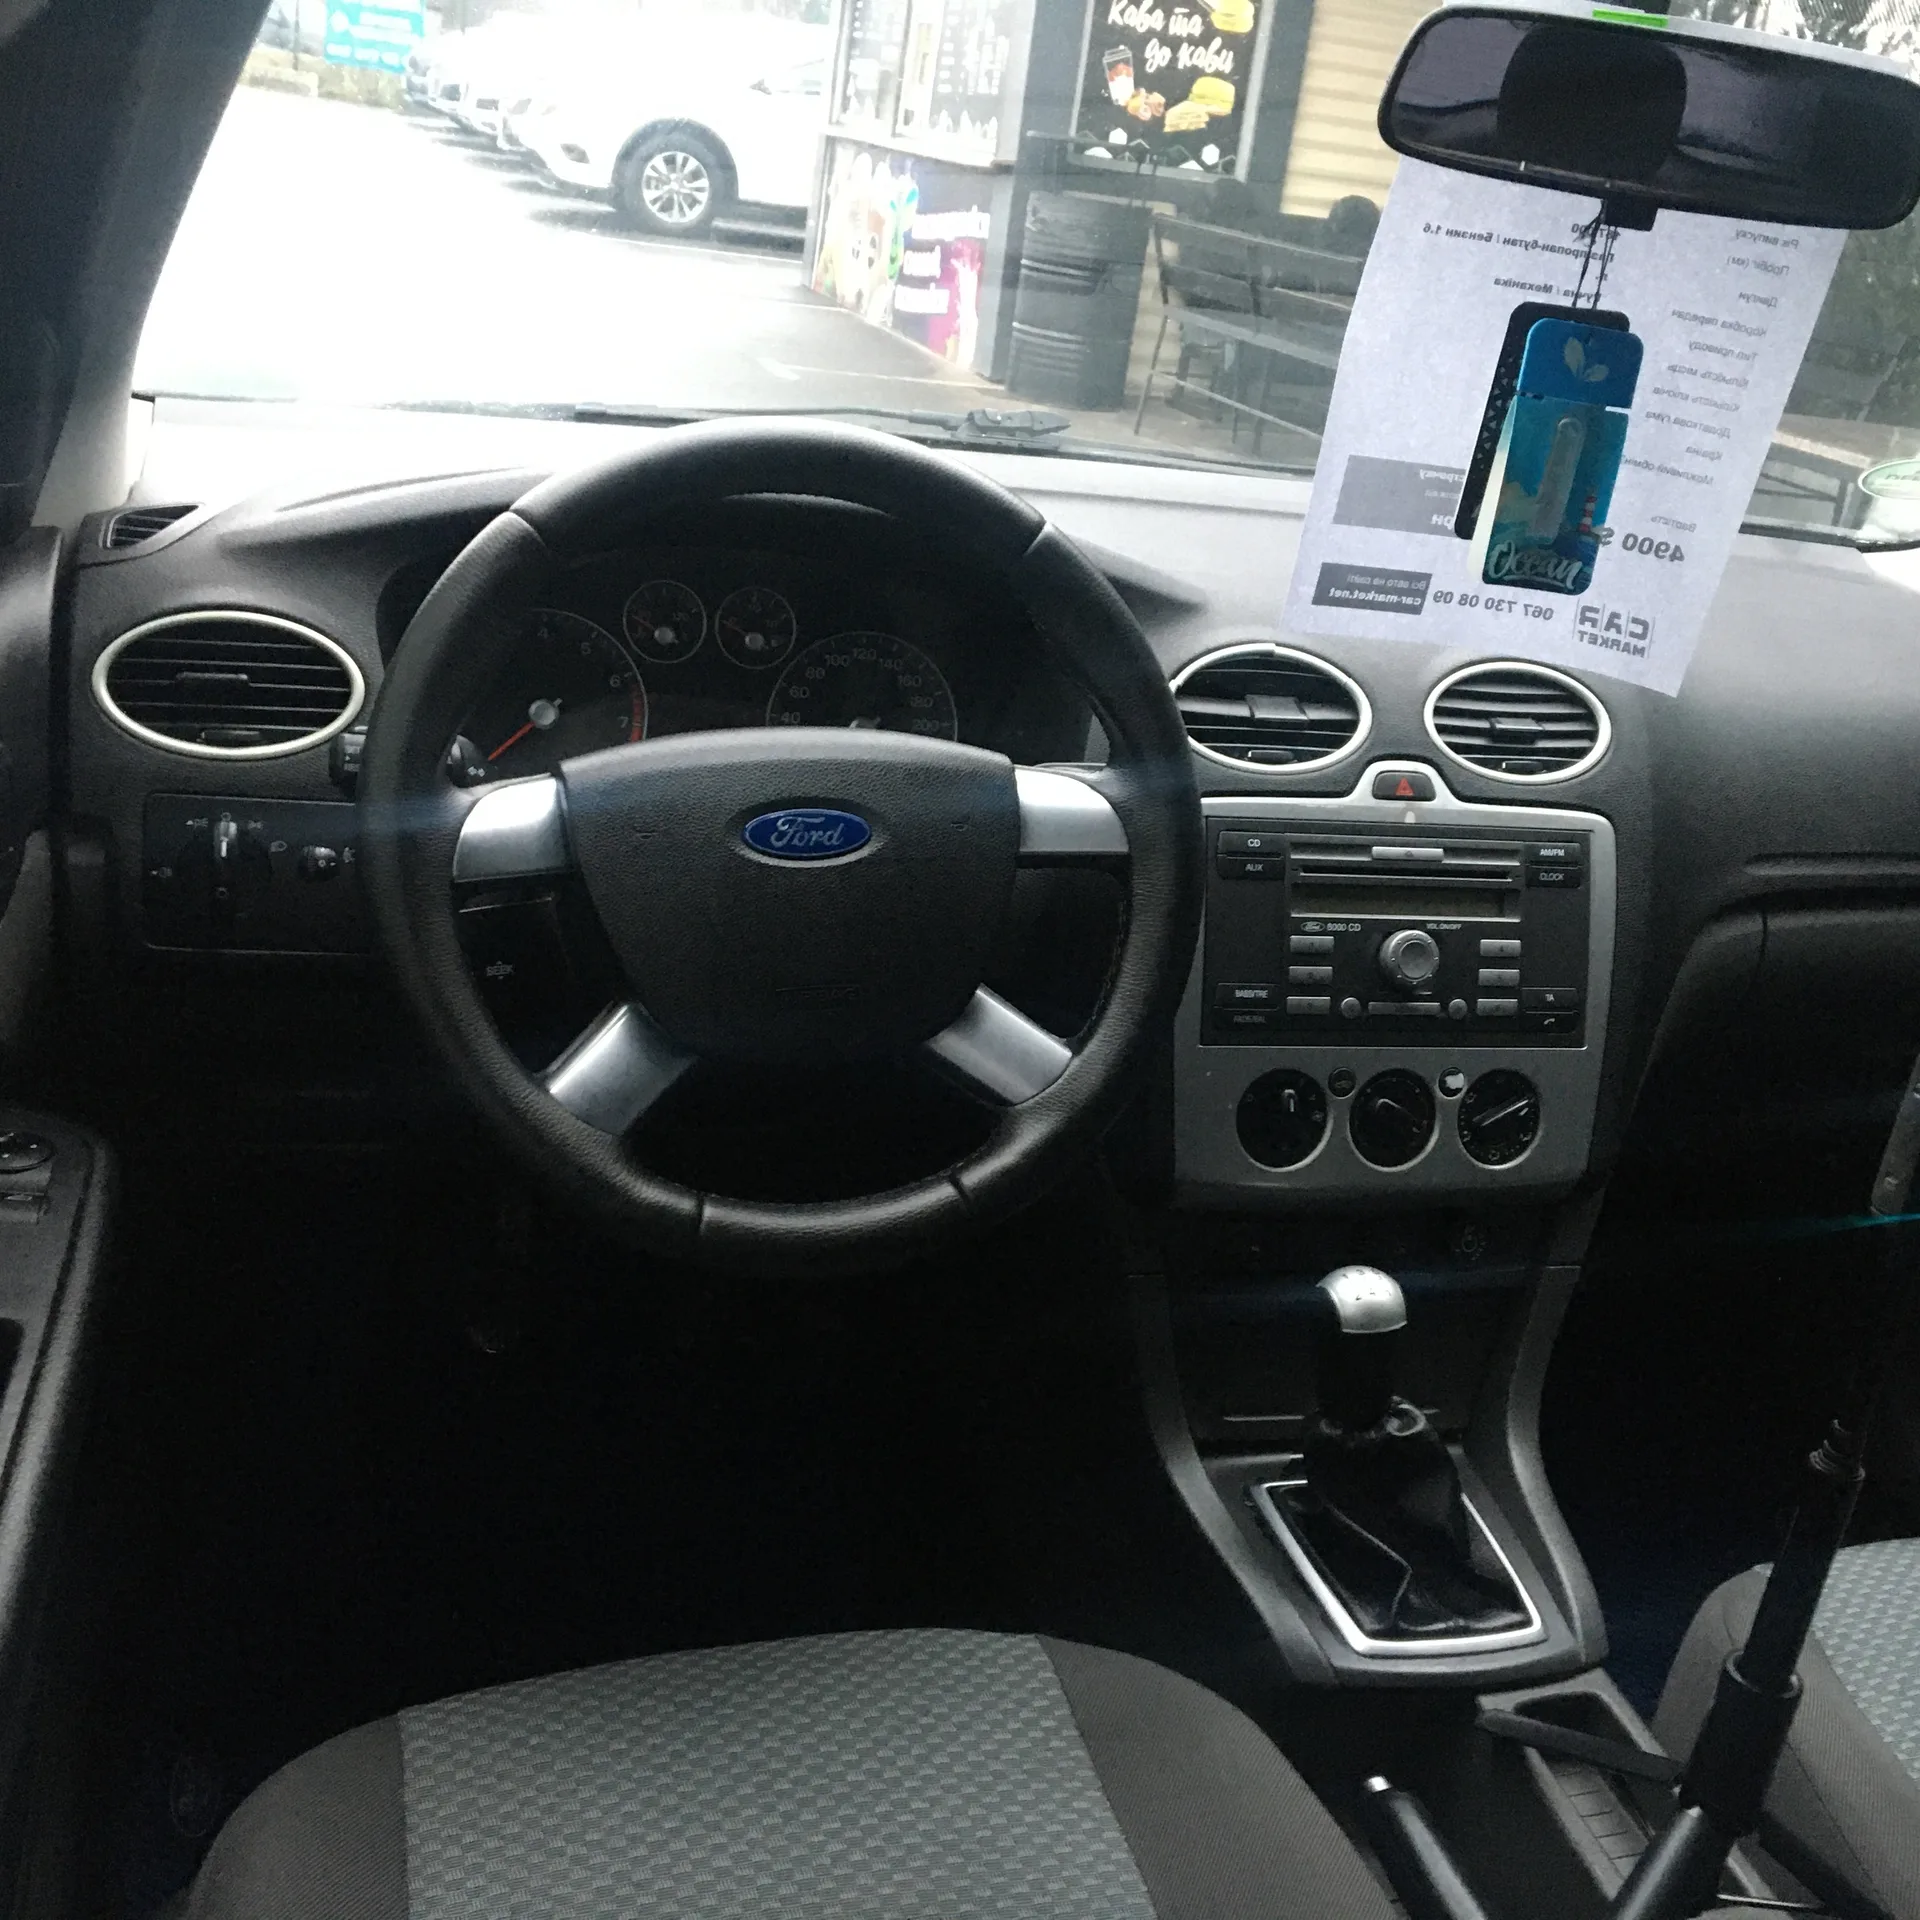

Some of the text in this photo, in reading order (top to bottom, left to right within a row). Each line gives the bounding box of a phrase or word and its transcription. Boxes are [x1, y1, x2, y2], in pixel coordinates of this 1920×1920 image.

[1144, 37, 1235, 74] до кави
[1486, 540, 1583, 590] Ocean
[580, 641, 592, 656] 5
[853, 647, 878, 661] 120
[804, 666, 826, 680] 80
[609, 674, 621, 688] 6
[788, 685, 811, 699] 60
[617, 715, 629, 729] 7
[780, 711, 802, 724] 40
[768, 814, 845, 848] Ford
[1247, 838, 1261, 847] CD
[1245, 863, 1263, 872] AUX
[1539, 872, 1565, 881] CLOCK
[1348, 923, 1361, 932] CD
